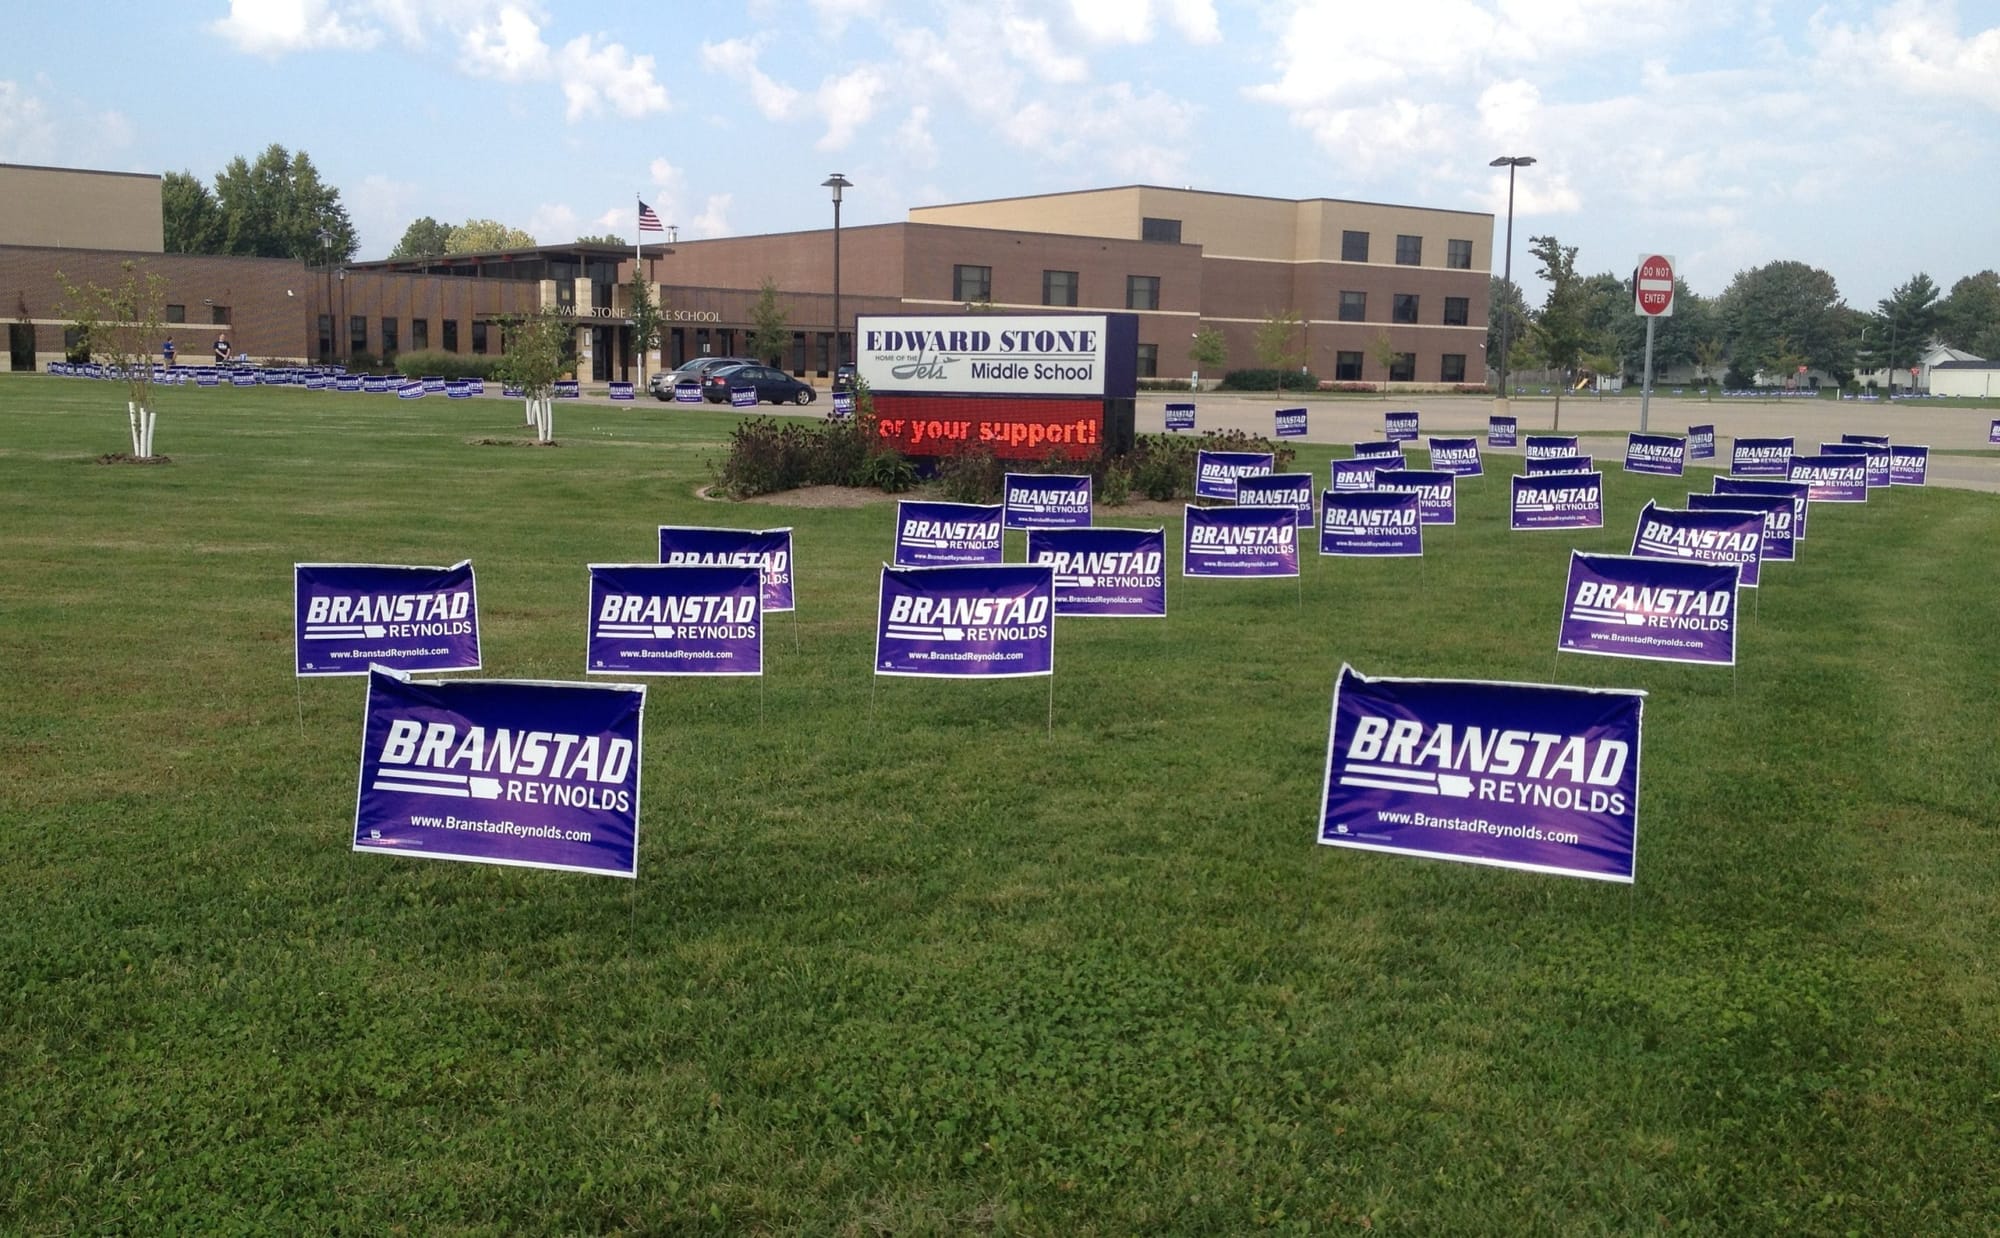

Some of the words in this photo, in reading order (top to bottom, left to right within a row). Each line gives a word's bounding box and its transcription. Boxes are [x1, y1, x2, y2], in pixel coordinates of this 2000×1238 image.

[1644, 266, 1653, 276] DO
[1656, 267, 1669, 277] NOT
[1644, 294, 1665, 304] ENTER
[674, 310, 722, 322] SCHOOL
[866, 330, 991, 352] EDWARD
[1000, 330, 1097, 352] STONE
[892, 350, 948, 380] Jets
[971, 362, 1028, 380] Middle
[1034, 362, 1092, 381] School
[911, 420, 971, 443] your
[979, 419, 1097, 447] support!
[1432, 448, 1476, 459] BRANSTAD
[1527, 446, 1576, 457] BRANSTAD
[1629, 443, 1683, 458] BRANSTAD
[1735, 447, 1791, 458] BRANSTAD
[1891, 456, 1925, 467] NSTAD
[1201, 464, 1270, 478] BRANSTAD
[1791, 466, 1865, 480] BRANSTAD
[1007, 488, 1088, 506] BRANSTAD
[1239, 489, 1310, 504] BRANSTAD
[1516, 487, 1599, 504] BRANSTAD
[1045, 505, 1088, 513] REYNOLDS
[1555, 502, 1599, 511] REYNOLDS
[1325, 508, 1416, 526] BRANSTAD
[902, 520, 1000, 540] BRANSTAD
[1190, 526, 1293, 544] BRANSTAD
[1367, 527, 1417, 535] REYNOLDS
[1643, 521, 1759, 552] BRANSTAD
[1764, 530, 1791, 539] OLDS
[949, 540, 999, 550] REYNOLDS
[1239, 544, 1294, 554] REYNOLDS
[1038, 551, 1161, 575] BRANSTAD
[1695, 549, 1756, 562] REYNOLDS
[761, 574, 789, 585] OLDS
[1097, 576, 1161, 588] REYNOLDS
[1574, 581, 1730, 616] BRANSTAD
[306, 592, 470, 624] BRANSTAD
[600, 596, 756, 623] BRANSTAD
[888, 595, 1049, 625] BRANSTAD
[388, 621, 472, 638] REYNOLDS
[677, 624, 756, 639] REYNOLDS
[1648, 616, 1729, 632] REYNOLDS
[967, 625, 1048, 641] REYNOLDS
[1591, 632, 1704, 649] www.BranstadReynolds.com
[330, 647, 449, 660] www.BranstadReynolds.com
[620, 649, 734, 661] www.BranstadReynolds.com
[908, 651, 1024, 662] www.BranstadReynolds.com
[379, 719, 633, 784] BRANSTAD
[1346, 716, 1629, 786] BRANSTAD
[506, 780, 629, 812] REYNOLDS
[1479, 779, 1625, 816] REYNOLDS
[410, 815, 591, 842] www.BranstadReynolds.com
[1378, 810, 1578, 844] www.BranstadReynolds.com
